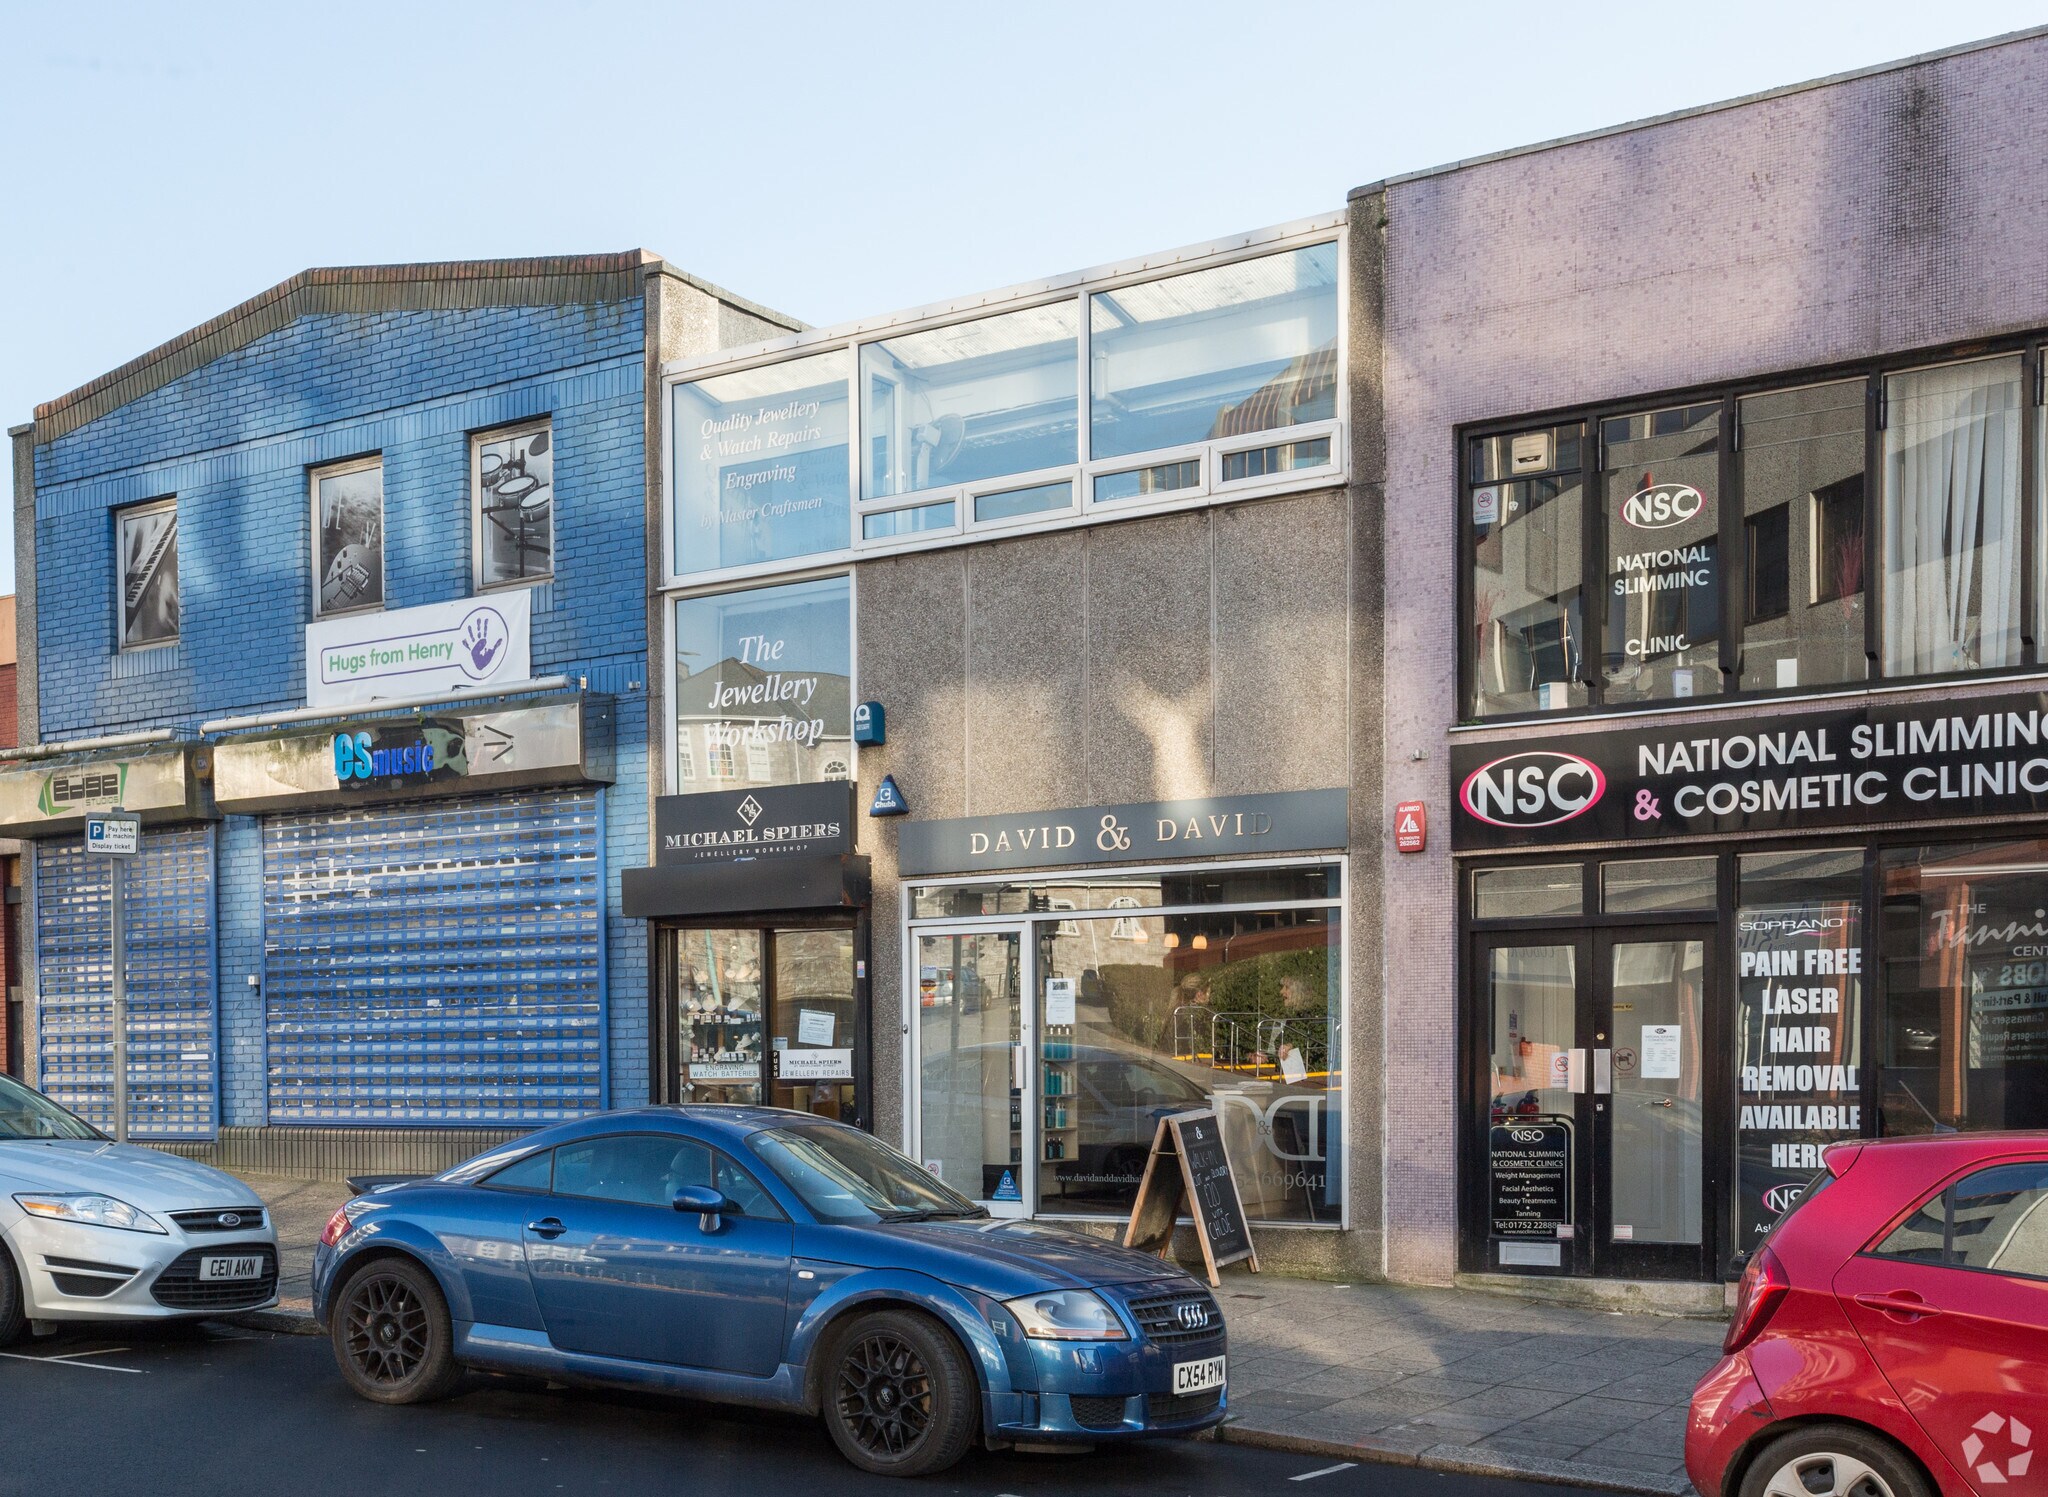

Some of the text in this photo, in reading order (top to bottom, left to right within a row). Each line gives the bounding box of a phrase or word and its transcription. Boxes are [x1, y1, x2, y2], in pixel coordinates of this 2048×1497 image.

[701, 400, 820, 440] Quality Jewellery
[700, 426, 822, 461] & Watch Repairs
[724, 464, 797, 491] Engraving
[719, 508, 758, 524] Master
[761, 497, 823, 517] Craftsmen
[1629, 489, 1698, 525] NSC
[1616, 545, 1711, 572] NATIONAL
[329, 641, 454, 674] Hugs from Henry
[738, 634, 785, 664] The
[1625, 633, 1691, 656] CLINIC
[708, 673, 818, 709] Jewellery
[703, 714, 824, 748] Workshop
[372, 740, 434, 777] music
[1637, 729, 1836, 777] NATIONAL
[85, 796, 119, 806] STUDIOS
[1476, 763, 1593, 817] NSC
[1634, 759, 2048, 821] & COSMETIC CLINIC
[874, 801, 897, 809] Chubb
[93, 826, 102, 837] P
[665, 822, 841, 848] MICHAEL SPIERS
[970, 811, 1274, 855] DAVID & DAVID
[92, 842, 112, 851] Display
[694, 845, 808, 859] JEWELLERY WORKSHOP
[1958, 903, 1987, 914] THE
[1740, 918, 1844, 932] SOPRANO
[1740, 947, 1862, 977] PAIN FREE
[1762, 987, 1839, 1015] LASER
[1769, 1026, 1831, 1053] HAIR
[822, 1069, 850, 1077] REPAIRS
[1742, 1065, 1860, 1092] REMOVAL
[1739, 1105, 1861, 1130] AVAILABLE
[1514, 1130, 1541, 1142] NSC
[1053, 1170, 1141, 1184] www.davidanddavidhai
[1262, 1171, 1326, 1191] 669641
[1495, 1172, 1561, 1180] Weight Management
[1499, 1197, 1557, 1205] Beauty Treatments
[1515, 1210, 1541, 1218] Tanning
[1208, 1213, 1236, 1240] CHLOE
[1495, 1221, 1508, 1229] Tel:
[1508, 1221, 1532, 1229] 01752
[210, 1258, 256, 1277] CE11 AKN
[1178, 1363, 1206, 1389] CX54
